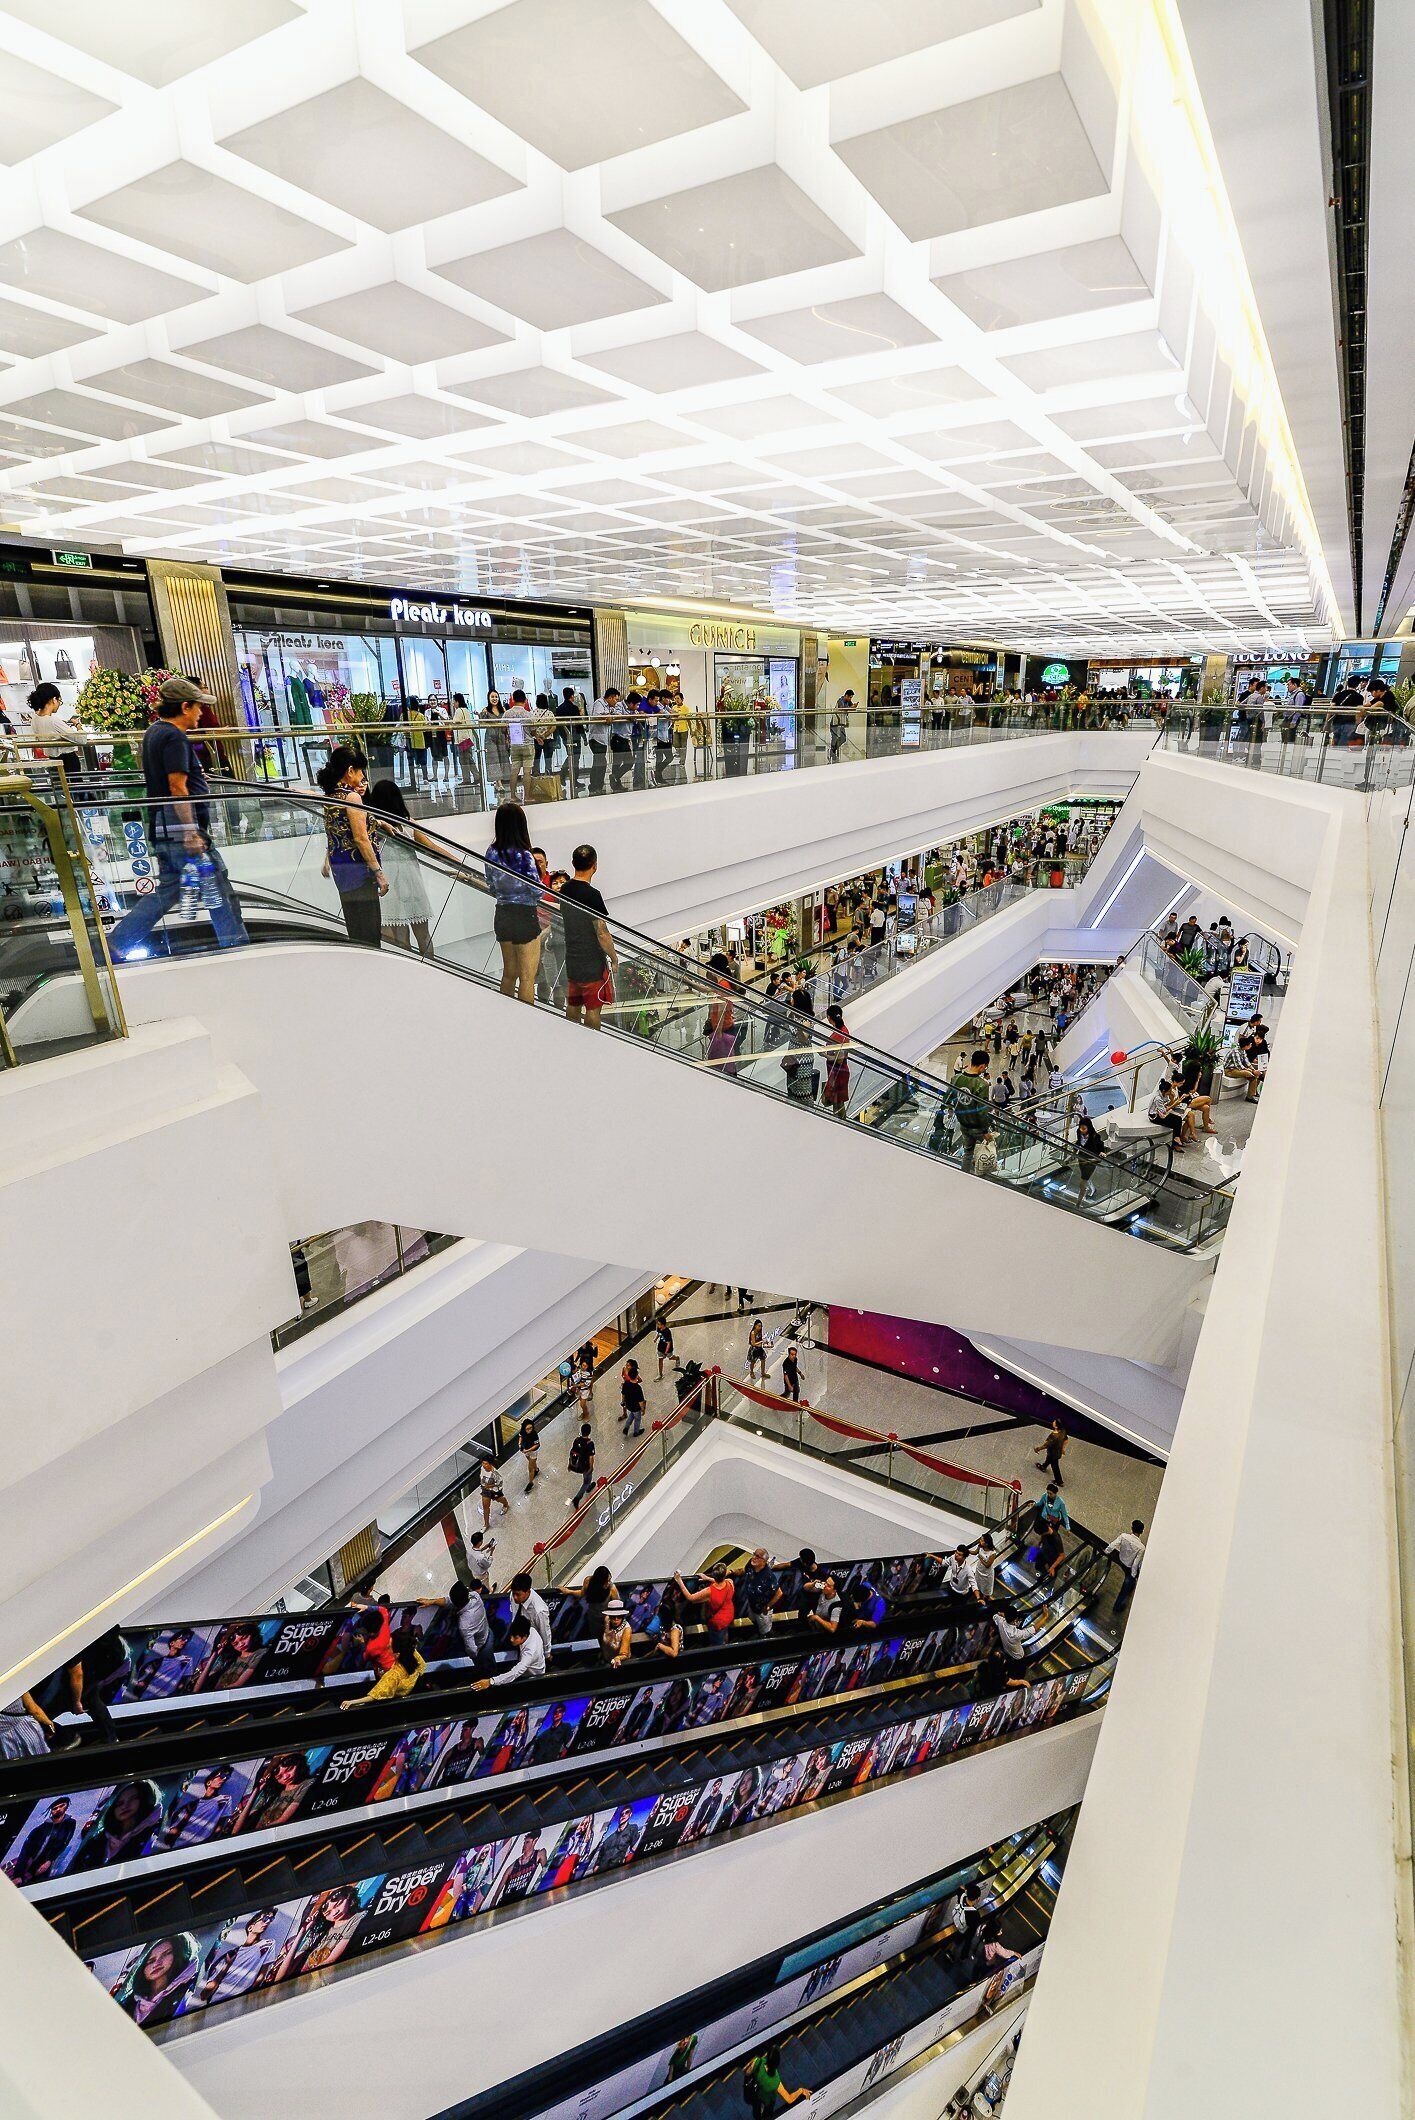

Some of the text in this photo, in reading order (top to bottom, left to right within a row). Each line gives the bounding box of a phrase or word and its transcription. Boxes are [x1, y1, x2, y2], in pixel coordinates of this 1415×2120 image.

[390, 597, 492, 627] Pleats kora
[280, 1624, 332, 1642] Super
[273, 1640, 305, 1655] Dry
[264, 1667, 289, 1678] L2-06
[770, 1665, 798, 1680] Super
[765, 1678, 782, 1690] Dry
[592, 1698, 630, 1716] Super
[586, 1713, 609, 1728] Dry
[329, 1745, 386, 1769] Super
[841, 1741, 870, 1758] Super
[836, 1756, 854, 1770] Dry
[321, 1766, 357, 1784] Dry
[311, 1796, 340, 1811] L2-06
[660, 1791, 700, 1813] Super
[652, 1810, 678, 1827] Dry
[643, 1838, 665, 1852] L2-06
[382, 1867, 444, 1897] Super
[373, 1892, 412, 1916] Dry
[361, 1927, 393, 1947] L2-06
